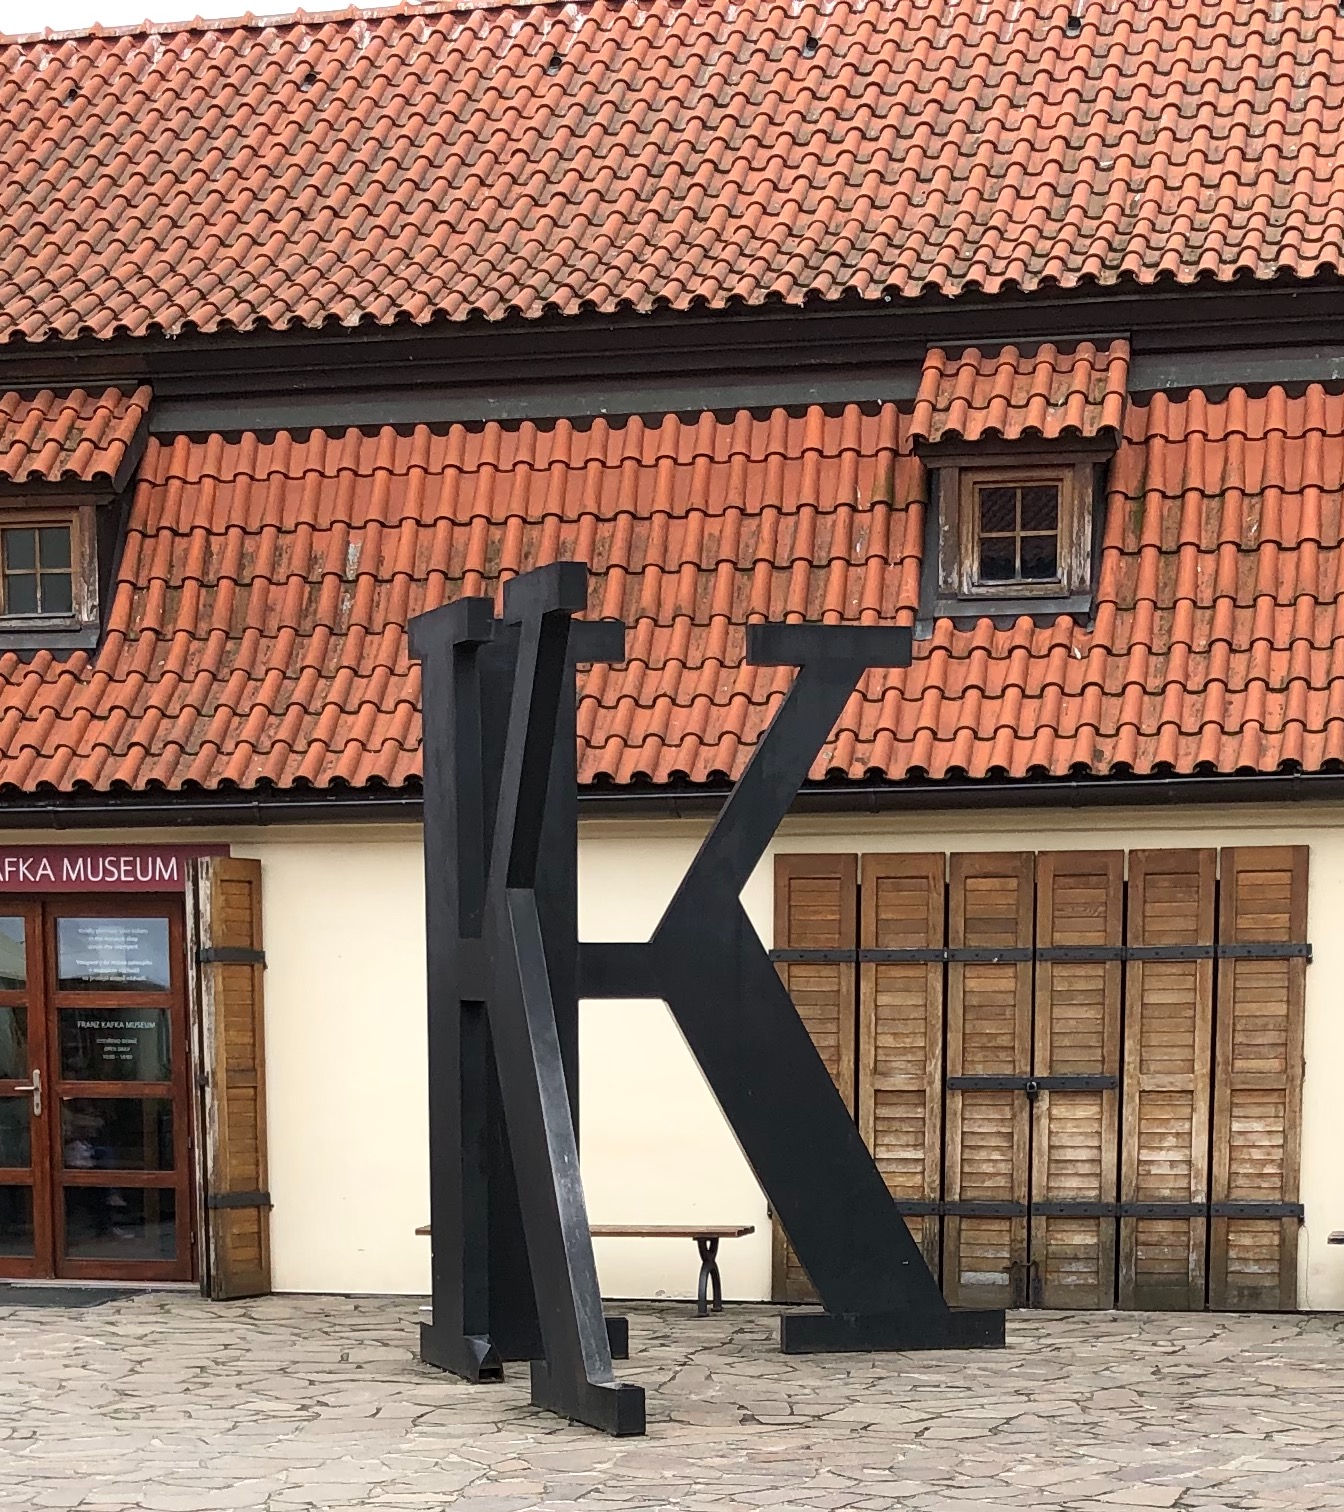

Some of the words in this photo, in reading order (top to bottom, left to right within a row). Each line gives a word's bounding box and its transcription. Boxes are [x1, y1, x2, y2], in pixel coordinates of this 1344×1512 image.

[62, 856, 179, 882] MUSEUM
[77, 1020, 100, 1029] FRANZ
[101, 1020, 125, 1029] KAFKA
[126, 1020, 156, 1029] MUSEUM
